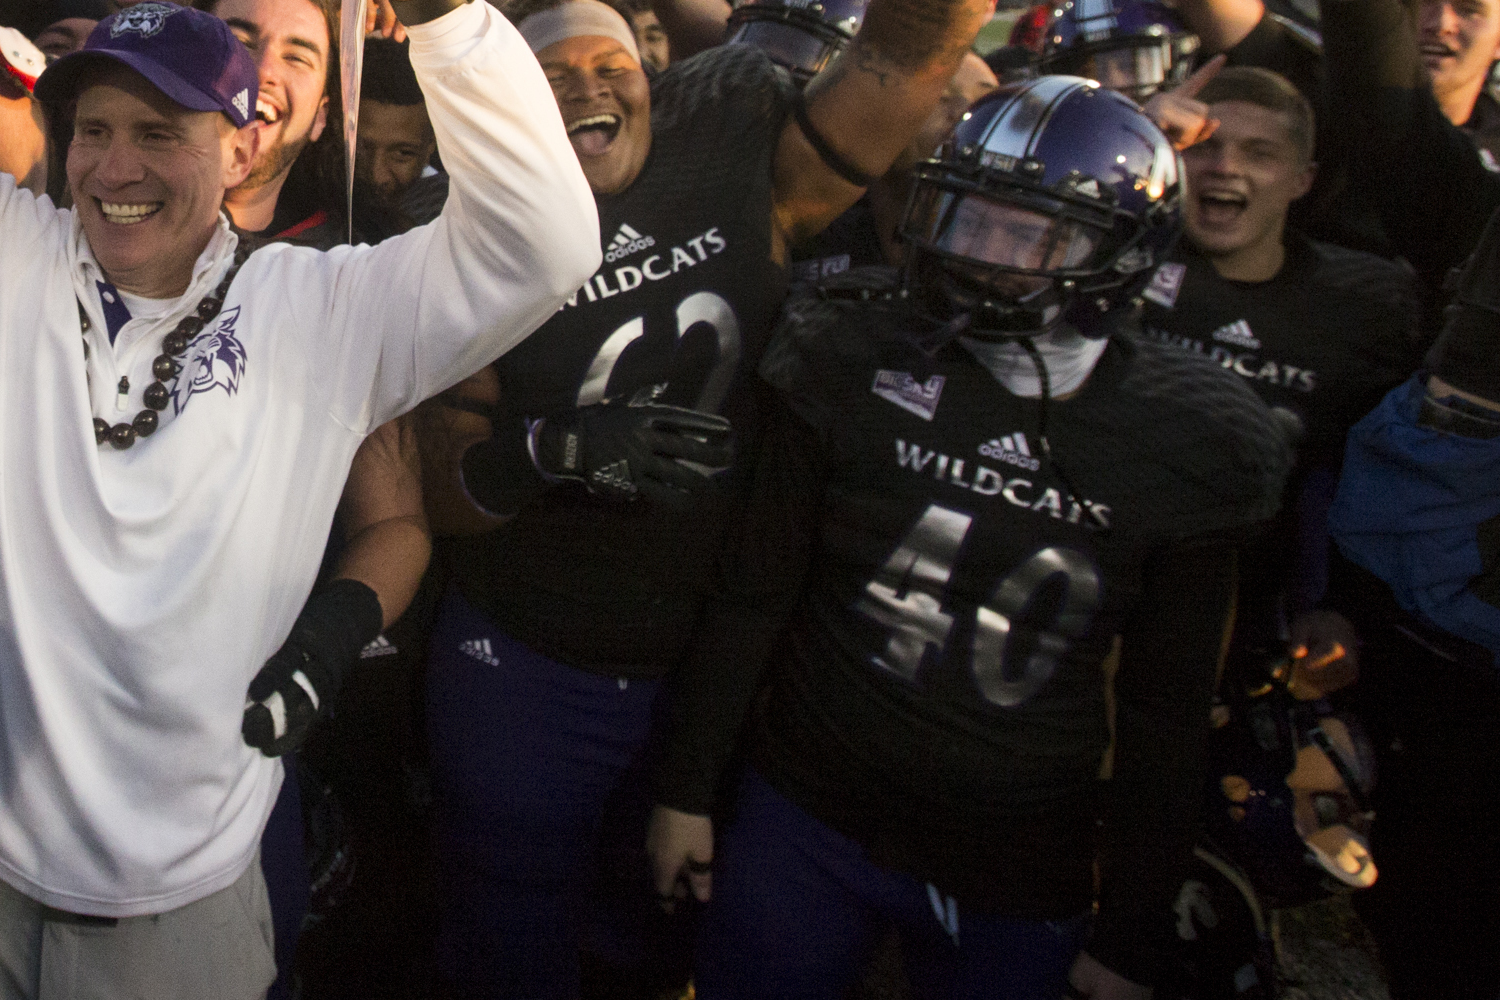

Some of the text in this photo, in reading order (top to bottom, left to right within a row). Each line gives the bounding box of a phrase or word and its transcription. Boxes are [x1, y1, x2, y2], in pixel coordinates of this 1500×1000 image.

[604, 235, 656, 263] adidas
[895, 438, 1112, 531] WILDCATS
[977, 443, 1041, 472] adidas
[855, 503, 1102, 707] 40
